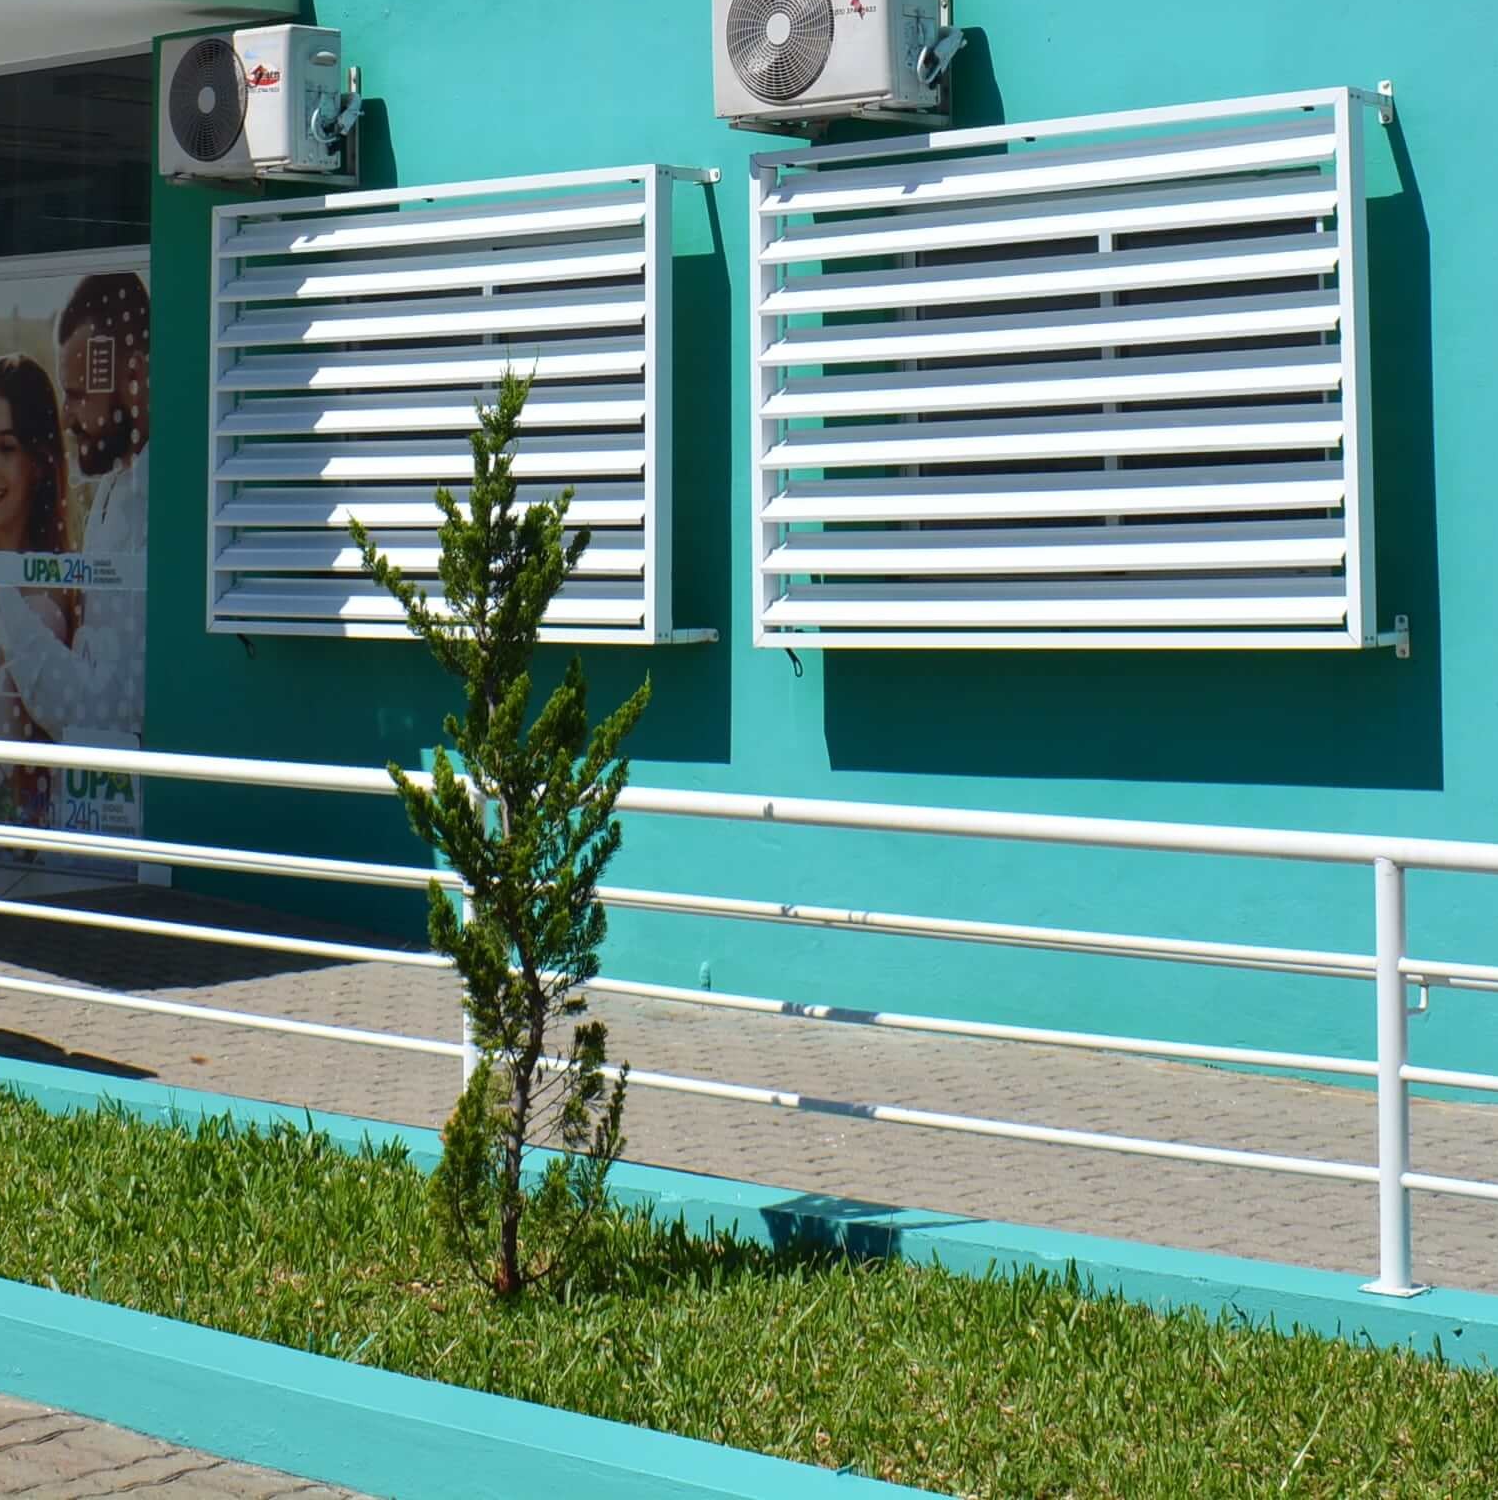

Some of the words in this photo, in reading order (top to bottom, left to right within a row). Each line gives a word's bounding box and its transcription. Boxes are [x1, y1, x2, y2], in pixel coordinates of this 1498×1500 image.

[23, 558, 61, 583] UPA
[63, 558, 93, 584] 24h
[67, 768, 135, 803] UPA
